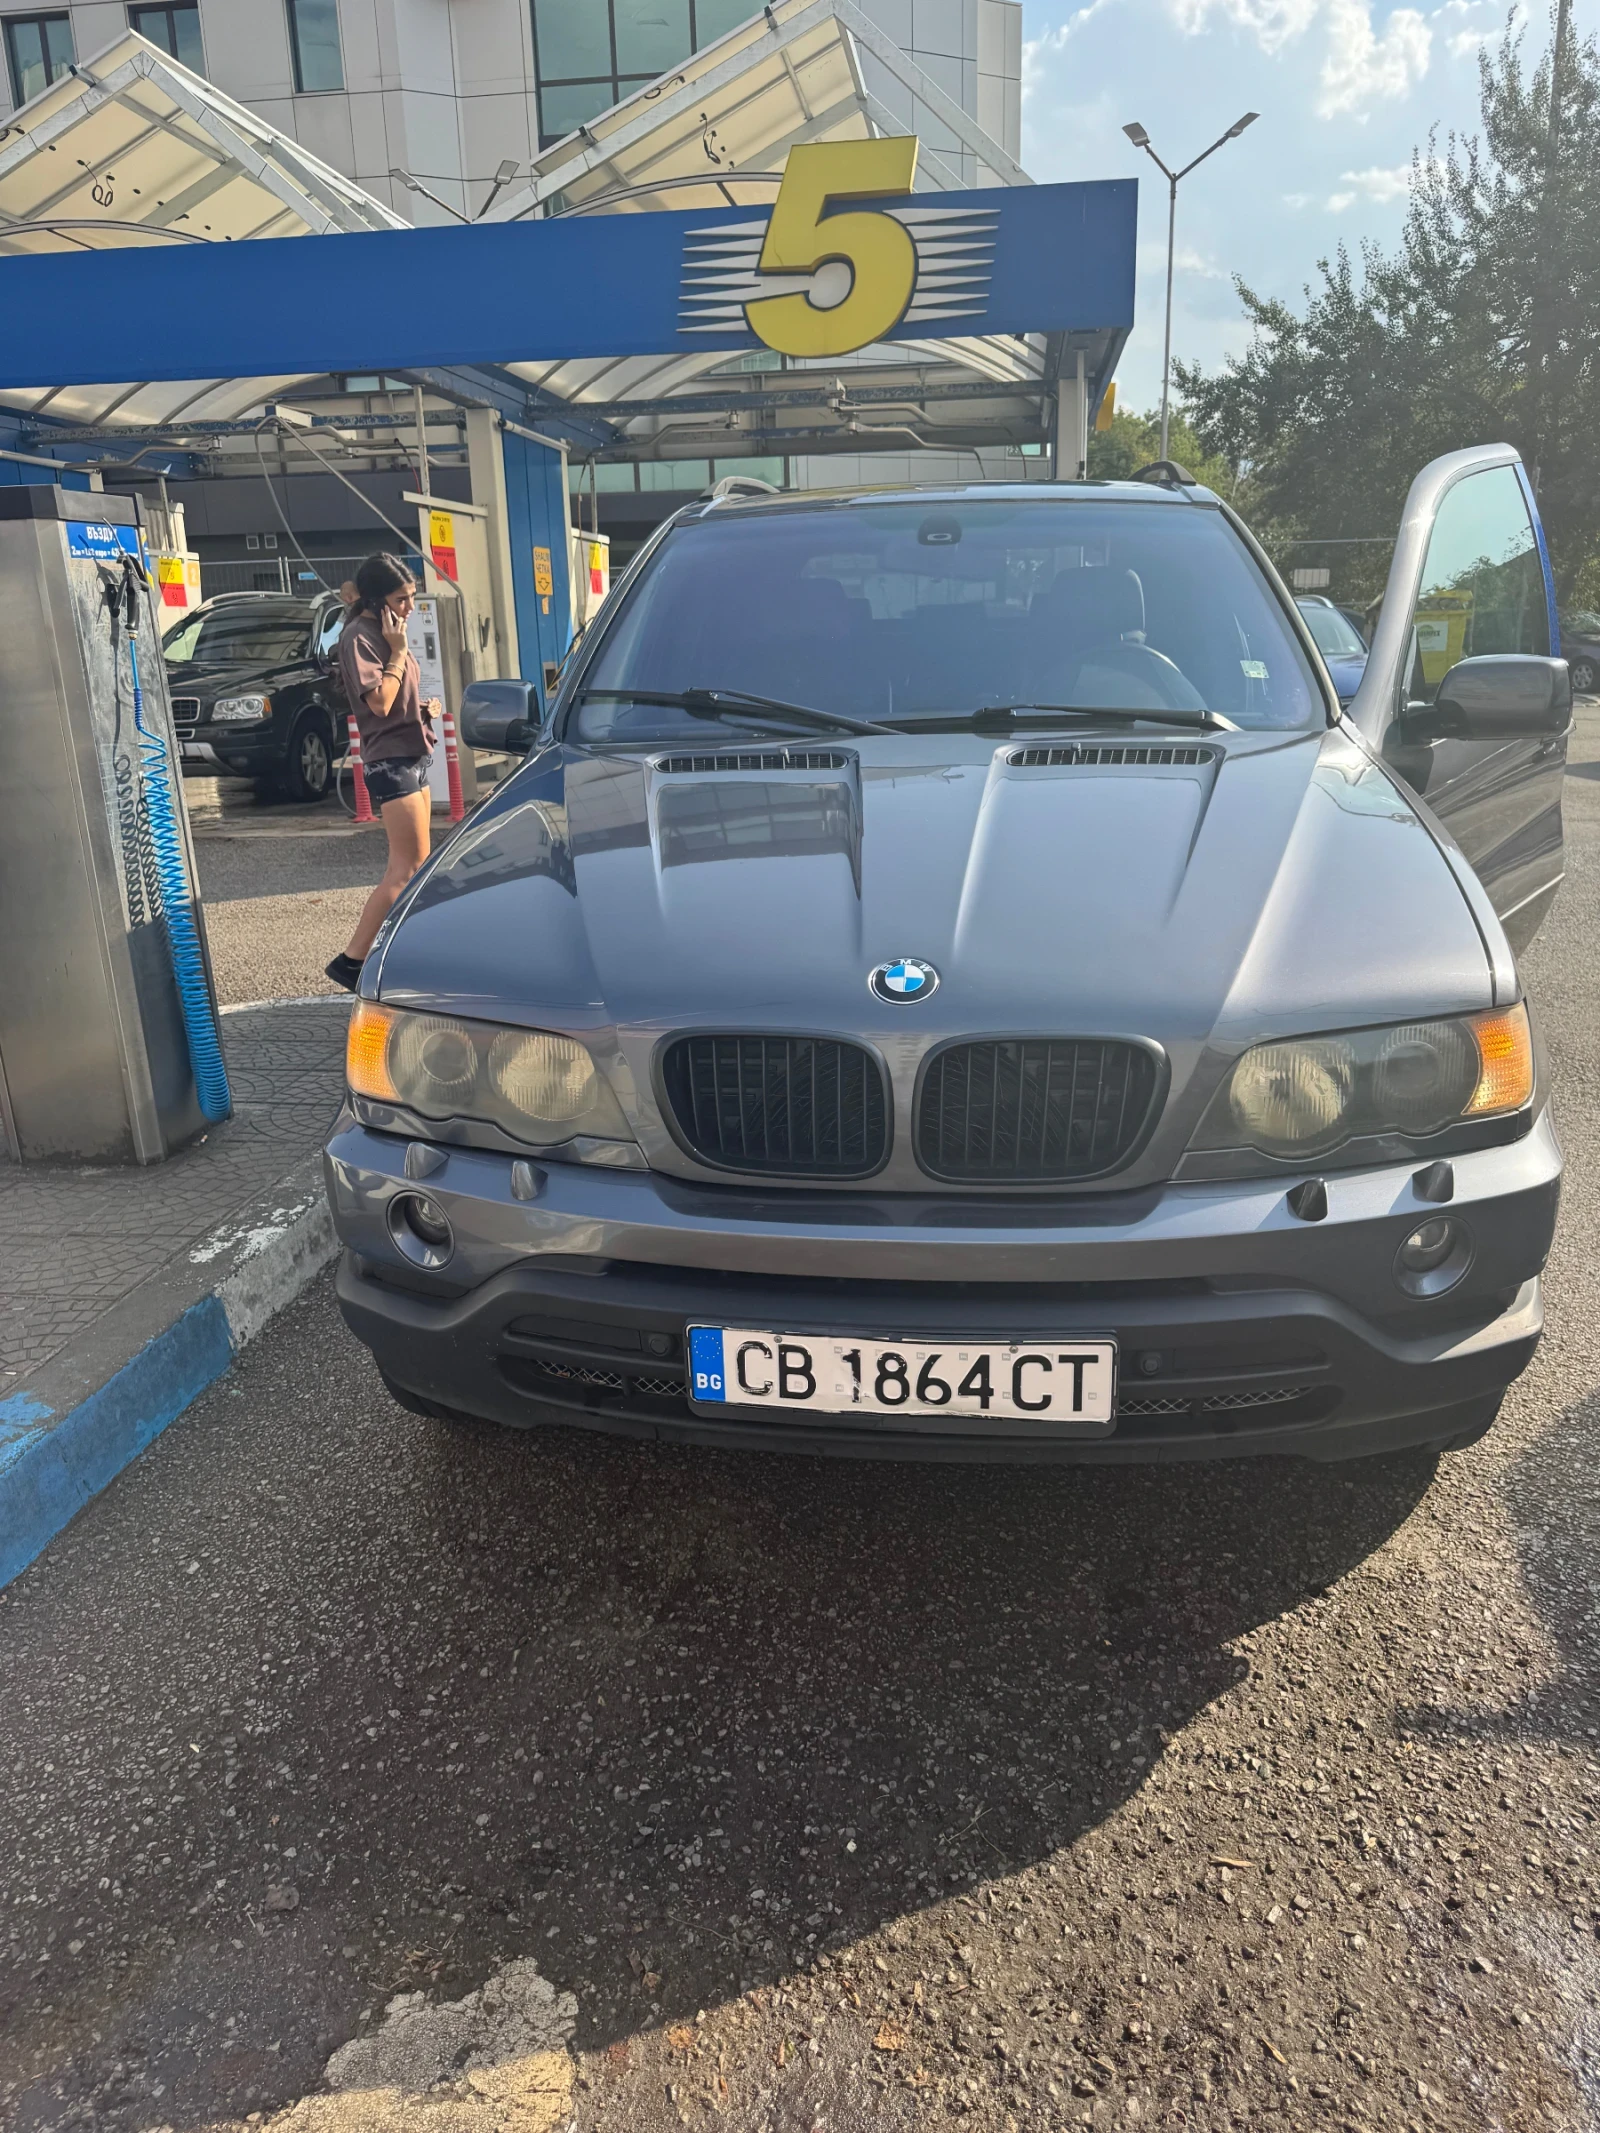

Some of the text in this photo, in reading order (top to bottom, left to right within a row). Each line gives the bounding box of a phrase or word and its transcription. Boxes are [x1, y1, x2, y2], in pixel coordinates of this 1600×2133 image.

[744, 135, 919, 358] 5
[880, 958, 933, 972] BMW
[696, 1373, 722, 1390] BG
[736, 1340, 1099, 1412] CB 1864 CT
